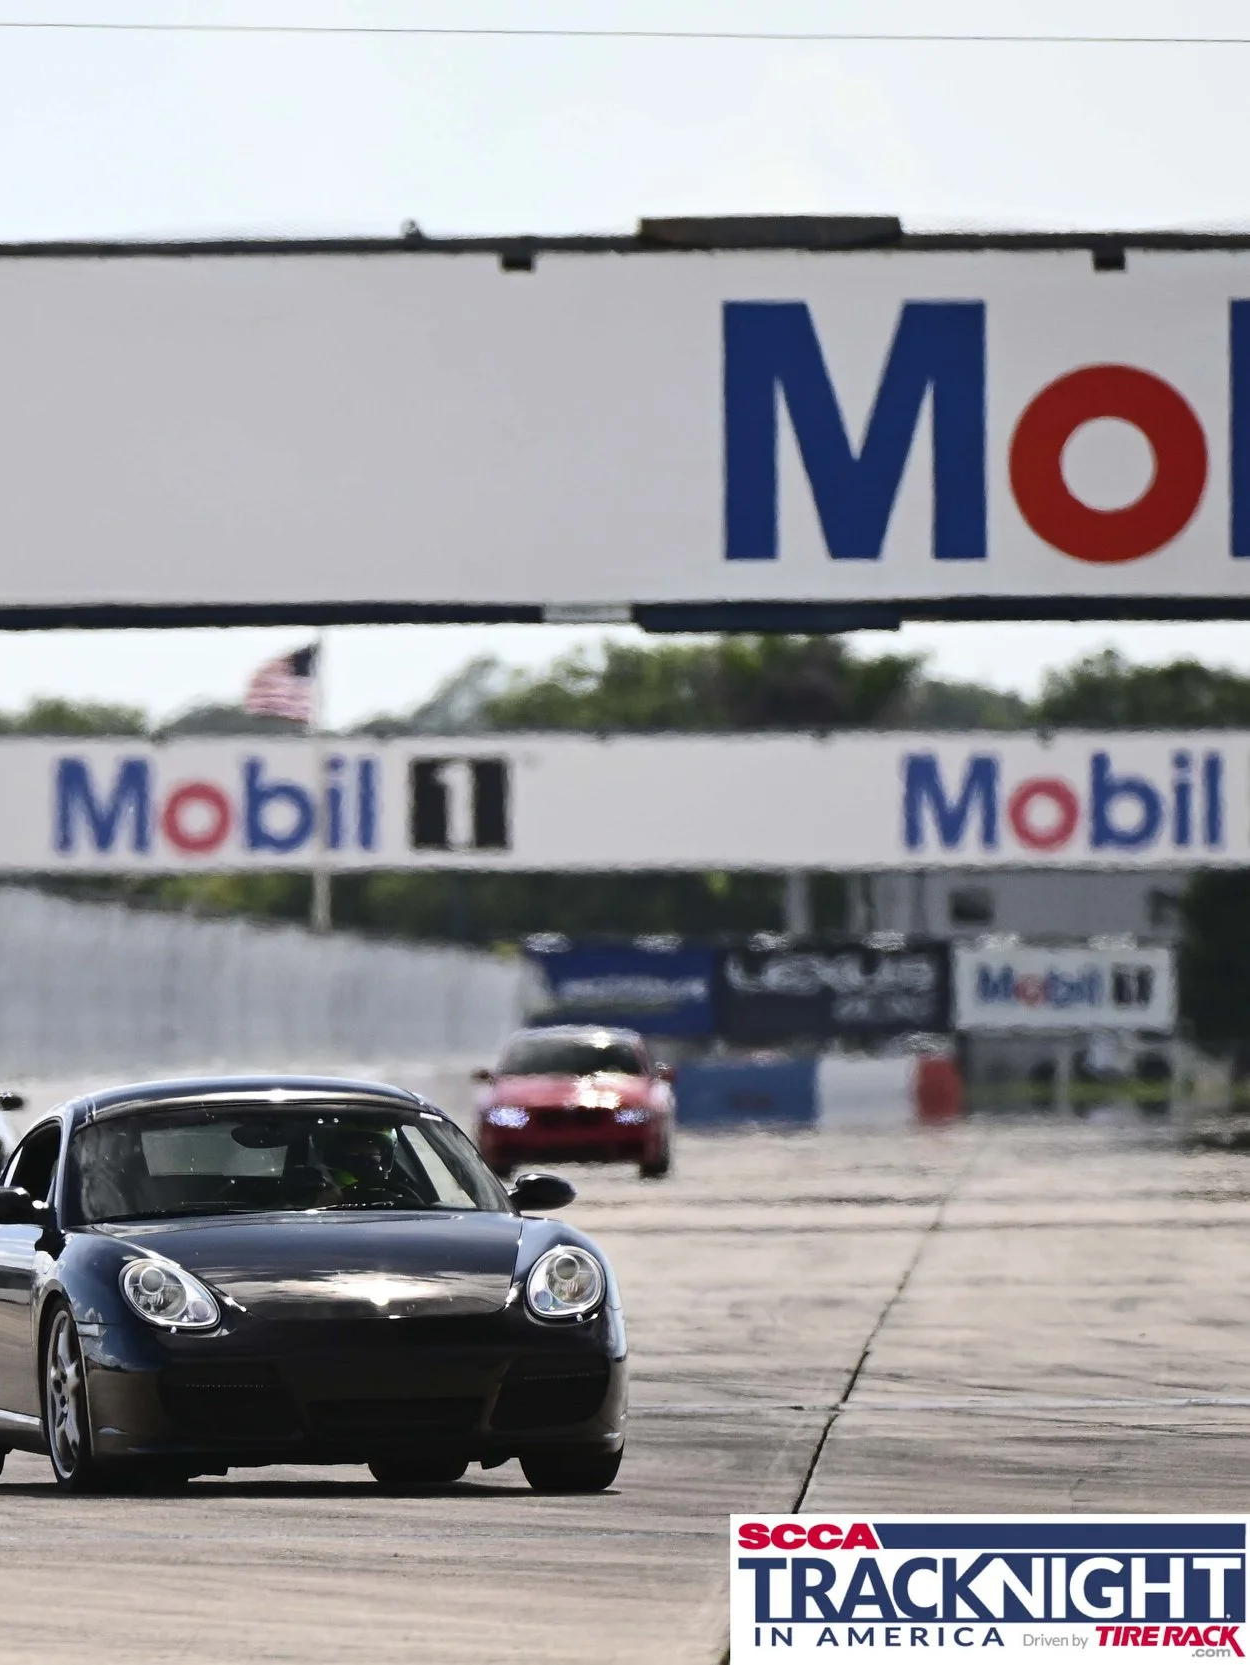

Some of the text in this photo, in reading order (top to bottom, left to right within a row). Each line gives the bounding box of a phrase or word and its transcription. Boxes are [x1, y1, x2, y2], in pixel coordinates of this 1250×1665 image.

[722, 299, 1250, 565] Mo
[57, 754, 378, 854] Mobil
[903, 751, 1225, 853] Mobil
[977, 962, 1105, 1009] Mobil
